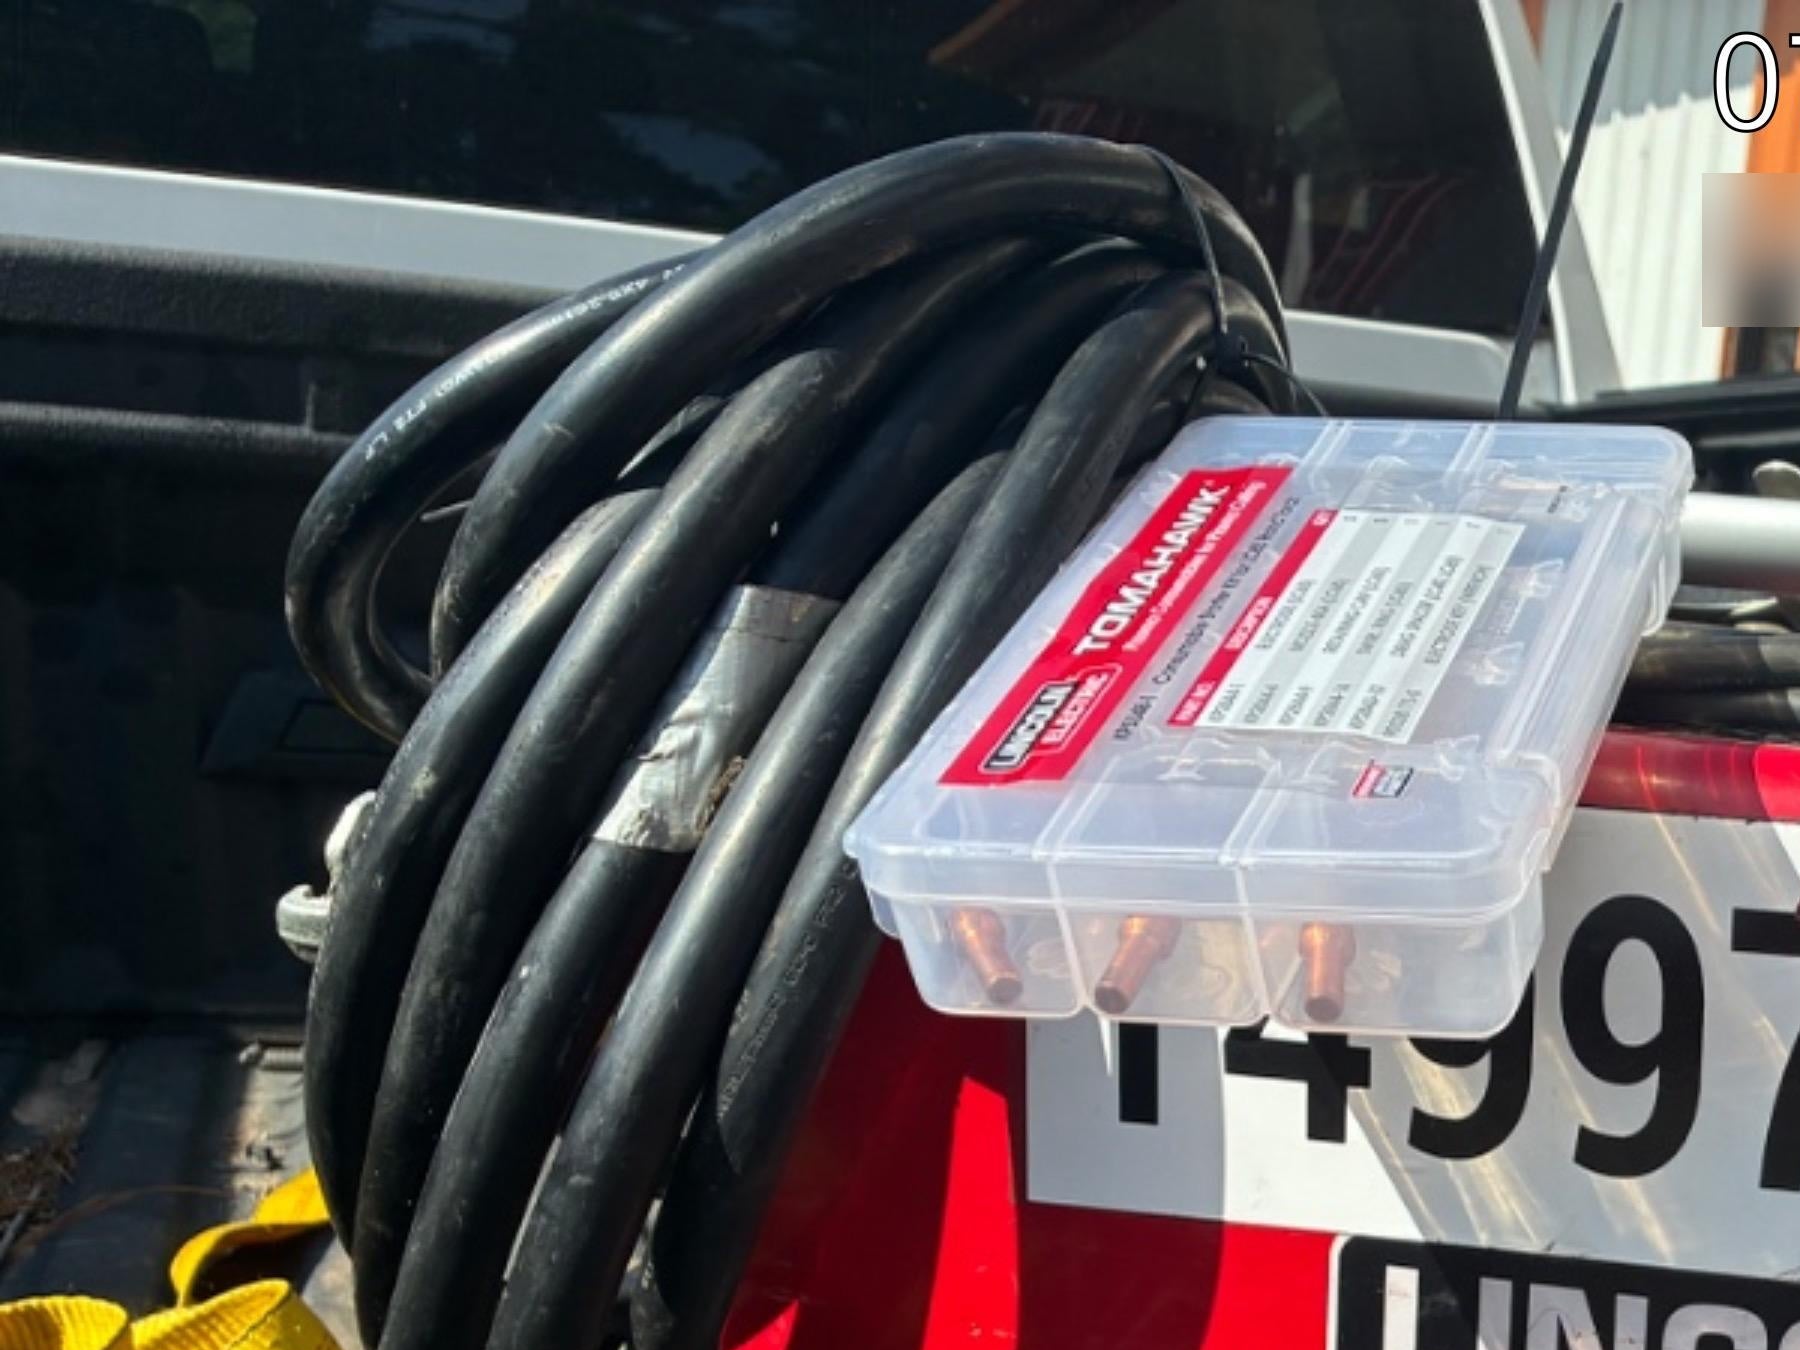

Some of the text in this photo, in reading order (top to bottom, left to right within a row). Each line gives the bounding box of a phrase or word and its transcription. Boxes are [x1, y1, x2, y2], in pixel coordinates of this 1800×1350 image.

[1072, 484, 1231, 656] TOMAHAWK
[987, 681, 1077, 768] LINCOLN
[1039, 672, 1109, 745] ELECTRIC
